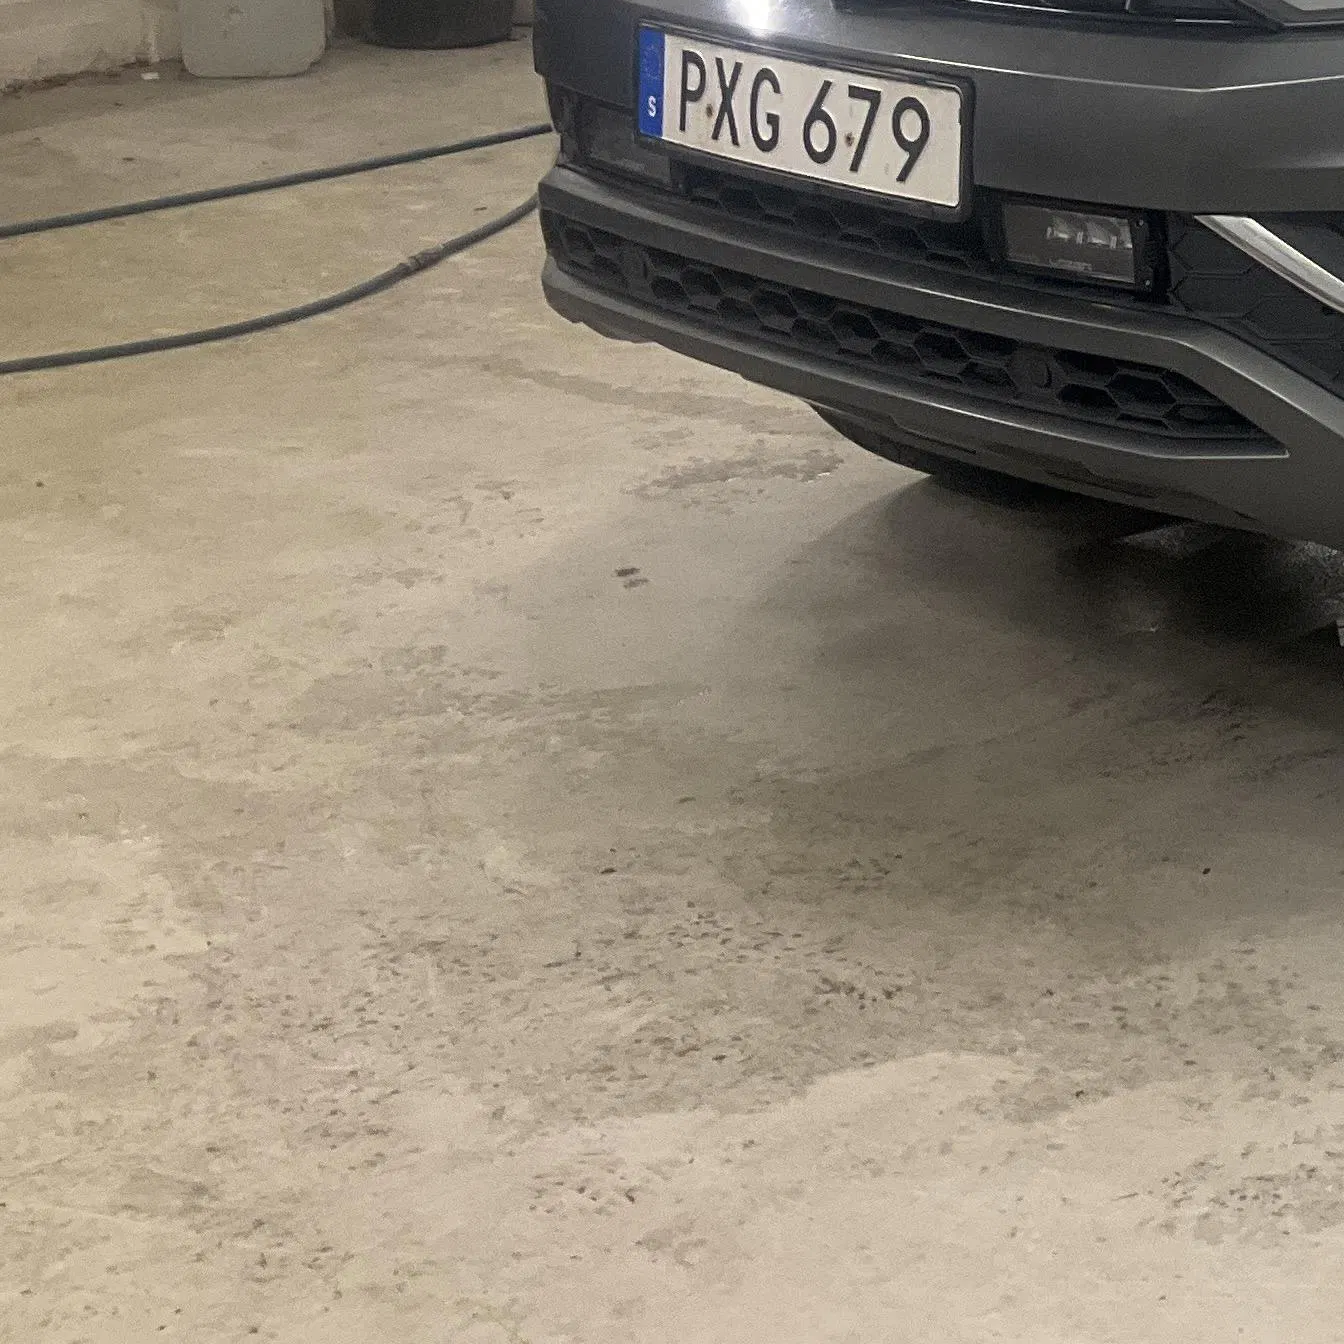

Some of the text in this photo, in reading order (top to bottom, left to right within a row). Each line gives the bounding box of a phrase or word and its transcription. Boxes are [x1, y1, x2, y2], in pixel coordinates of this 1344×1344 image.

[647, 95, 657, 118] S
[679, 49, 931, 183] PXG 679
